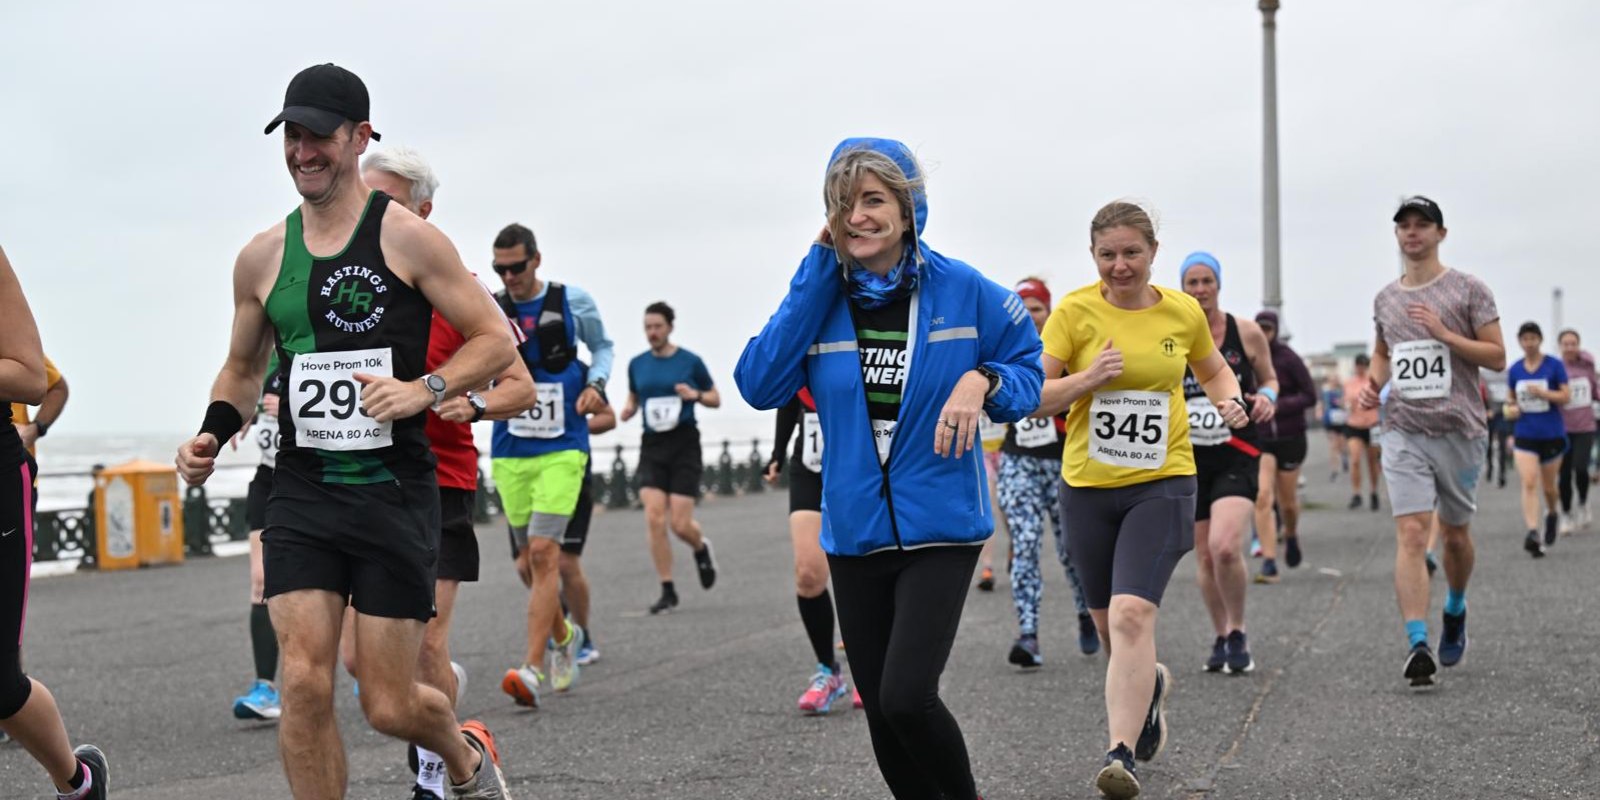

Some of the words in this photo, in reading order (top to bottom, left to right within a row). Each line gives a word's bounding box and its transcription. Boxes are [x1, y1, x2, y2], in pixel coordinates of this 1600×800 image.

[320, 265, 388, 298] HASTINGS
[336, 280, 374, 314] HR
[325, 306, 385, 333] RUNNERS
[301, 362, 331, 371] Hove
[333, 360, 362, 371] Prom
[364, 357, 383, 368] 10k
[1396, 355, 1446, 380] 204
[298, 379, 373, 420] 29
[516, 400, 556, 420] 61
[1100, 398, 1122, 406] Hove
[1123, 397, 1147, 406] Prom
[1148, 398, 1162, 407] 10k
[306, 429, 344, 440] ARENA
[346, 429, 361, 439] 80
[364, 427, 381, 438] AC
[1095, 411, 1163, 445] 345
[1097, 446, 1128, 459] ARENA
[1129, 451, 1143, 460] 80
[1144, 452, 1158, 461] AC
